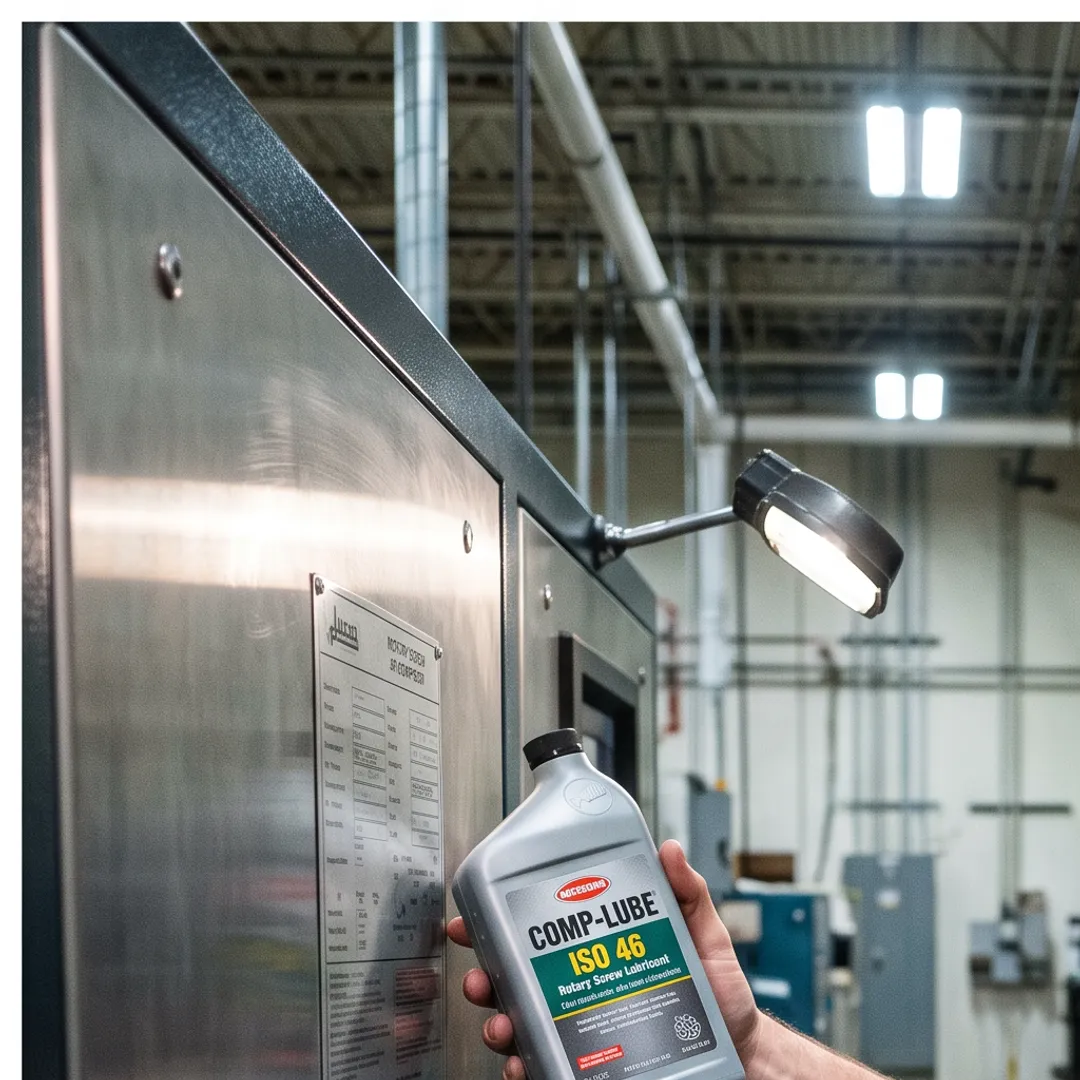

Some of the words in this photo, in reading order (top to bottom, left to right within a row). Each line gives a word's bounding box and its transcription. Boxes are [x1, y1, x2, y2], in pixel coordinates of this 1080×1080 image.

[528, 891, 659, 951] COMP-LUBE
[568, 943, 611, 977] ISO
[616, 933, 646, 961] 46
